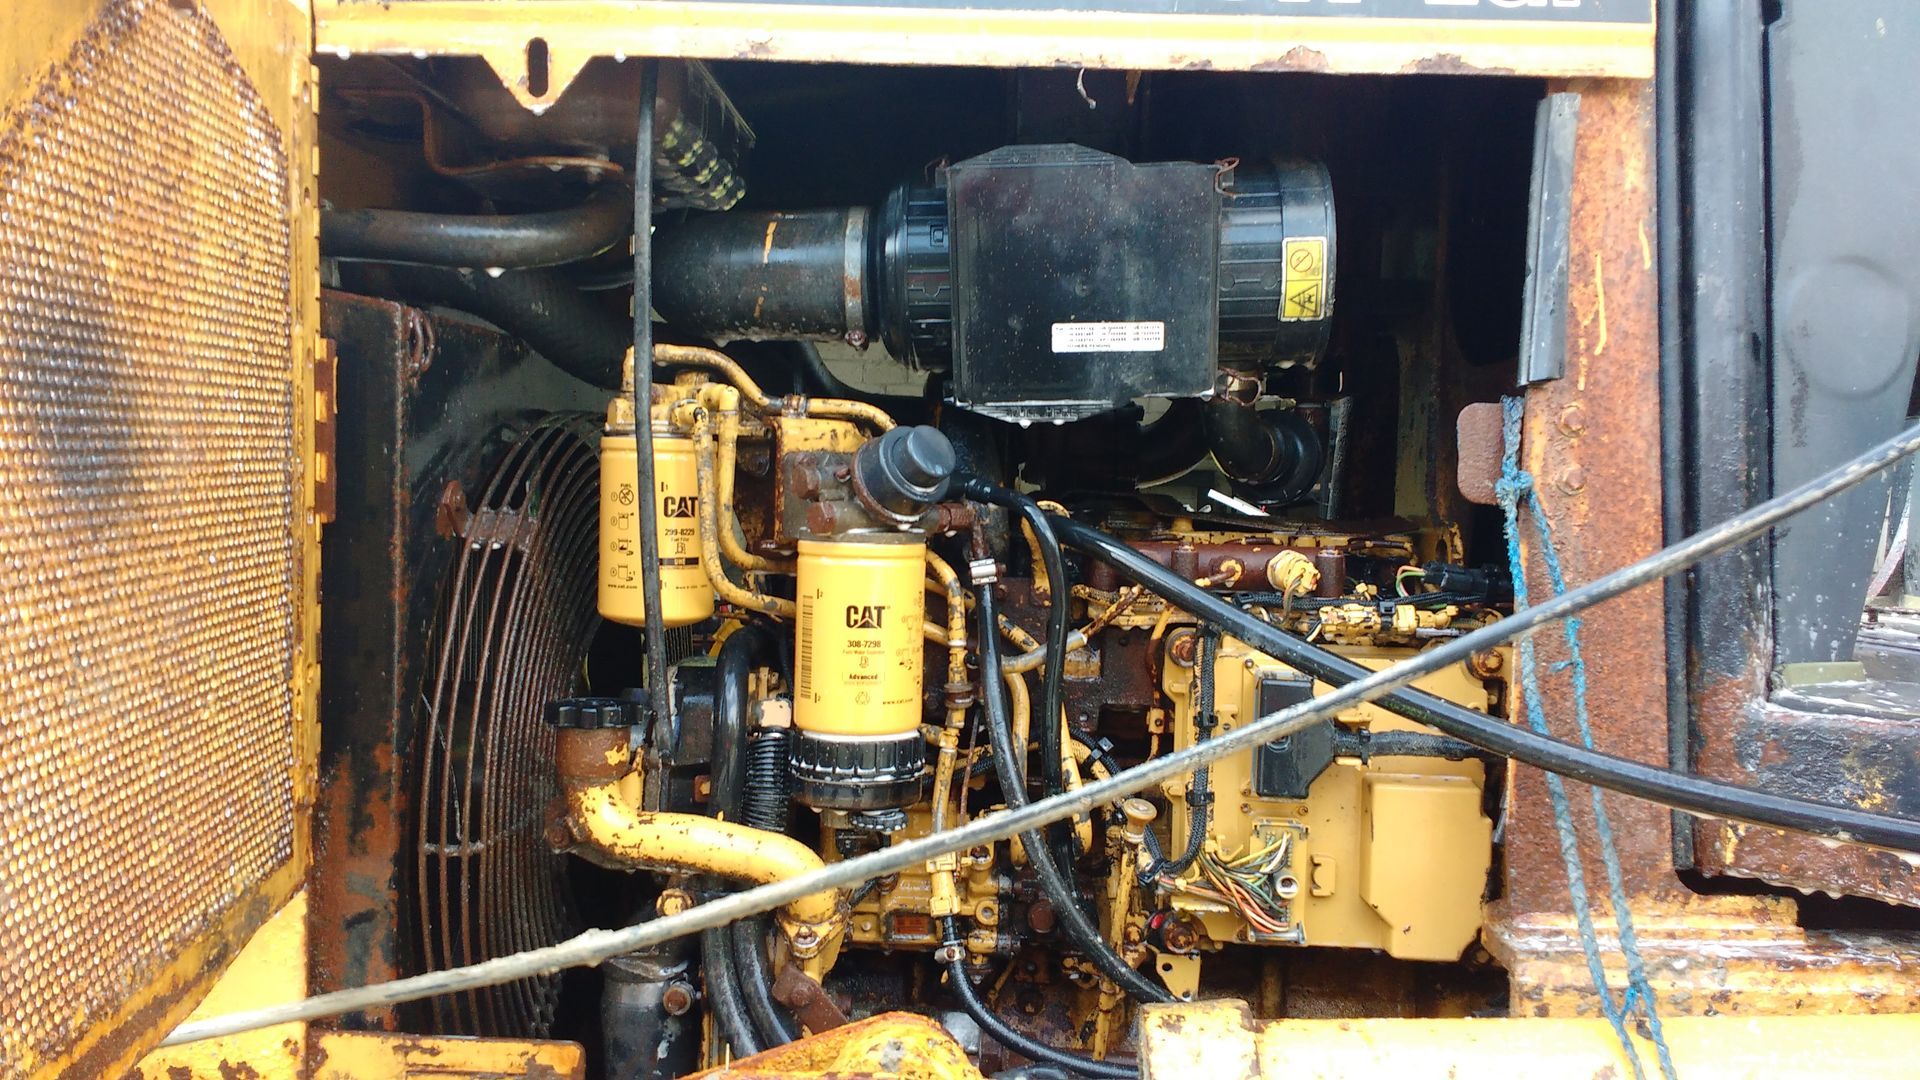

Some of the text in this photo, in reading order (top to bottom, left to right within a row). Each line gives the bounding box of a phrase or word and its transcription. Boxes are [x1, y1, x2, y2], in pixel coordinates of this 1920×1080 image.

[663, 496, 698, 518] CAT
[846, 605, 885, 628] CAT
[847, 640, 882, 648] 308-7298
